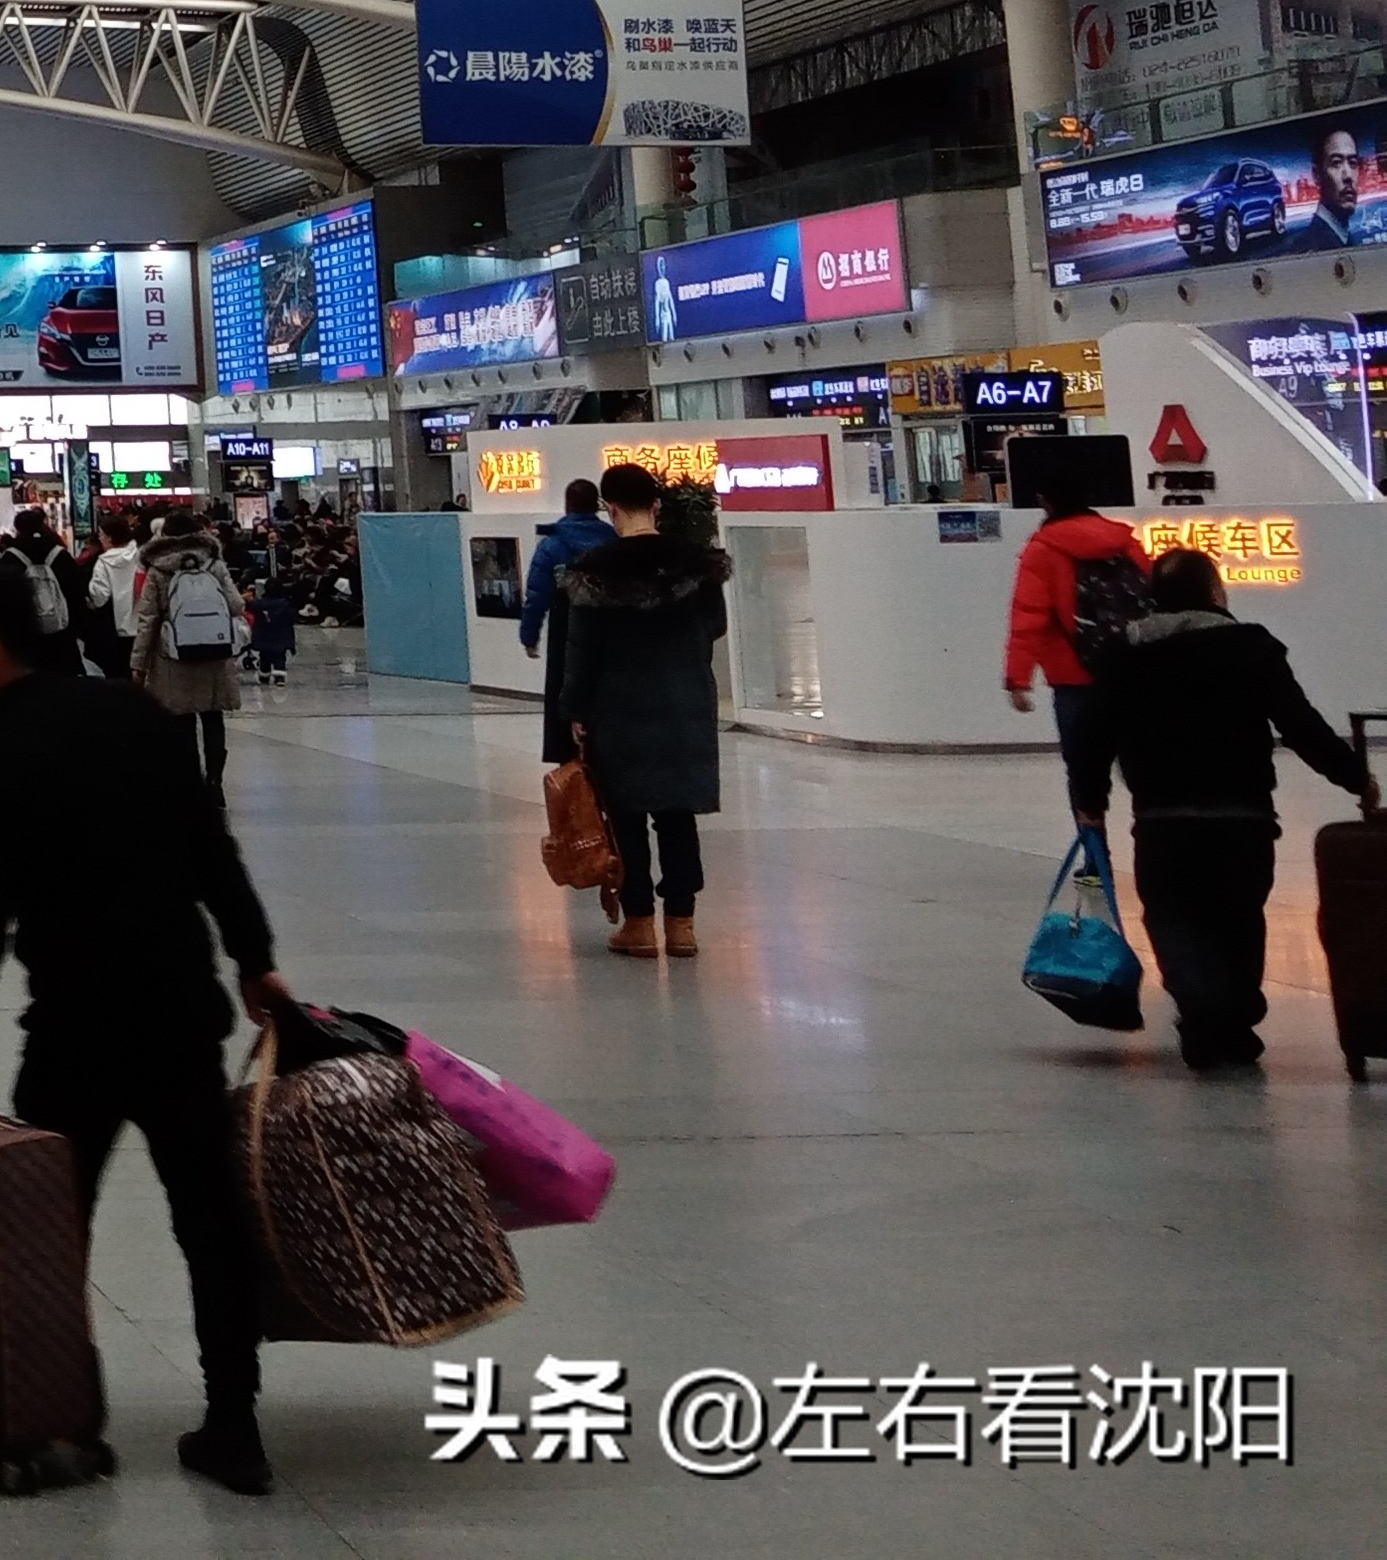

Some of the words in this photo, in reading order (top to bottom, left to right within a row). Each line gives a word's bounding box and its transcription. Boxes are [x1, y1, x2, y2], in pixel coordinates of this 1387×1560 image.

[623, 18, 675, 35] 刷水漆
[685, 18, 737, 35] 唤蓝天
[1128, 40, 1148, 51] RUI
[1150, 33, 1170, 46] CHI
[1170, 26, 1201, 42] HENG
[1202, 20, 1220, 34] DA
[465, 50, 595, 82] 晨陽水漆
[1047, 183, 1100, 208] 全新一代
[837, 247, 890, 278] 招商银行
[143, 264, 169, 351] 东风日产
[1251, 363, 1295, 378] Business
[1294, 361, 1314, 376] Vip
[976, 380, 1052, 405] A6-A7
[226, 442, 270, 457] A10-A11
[1224, 565, 1303, 585] Lounge
